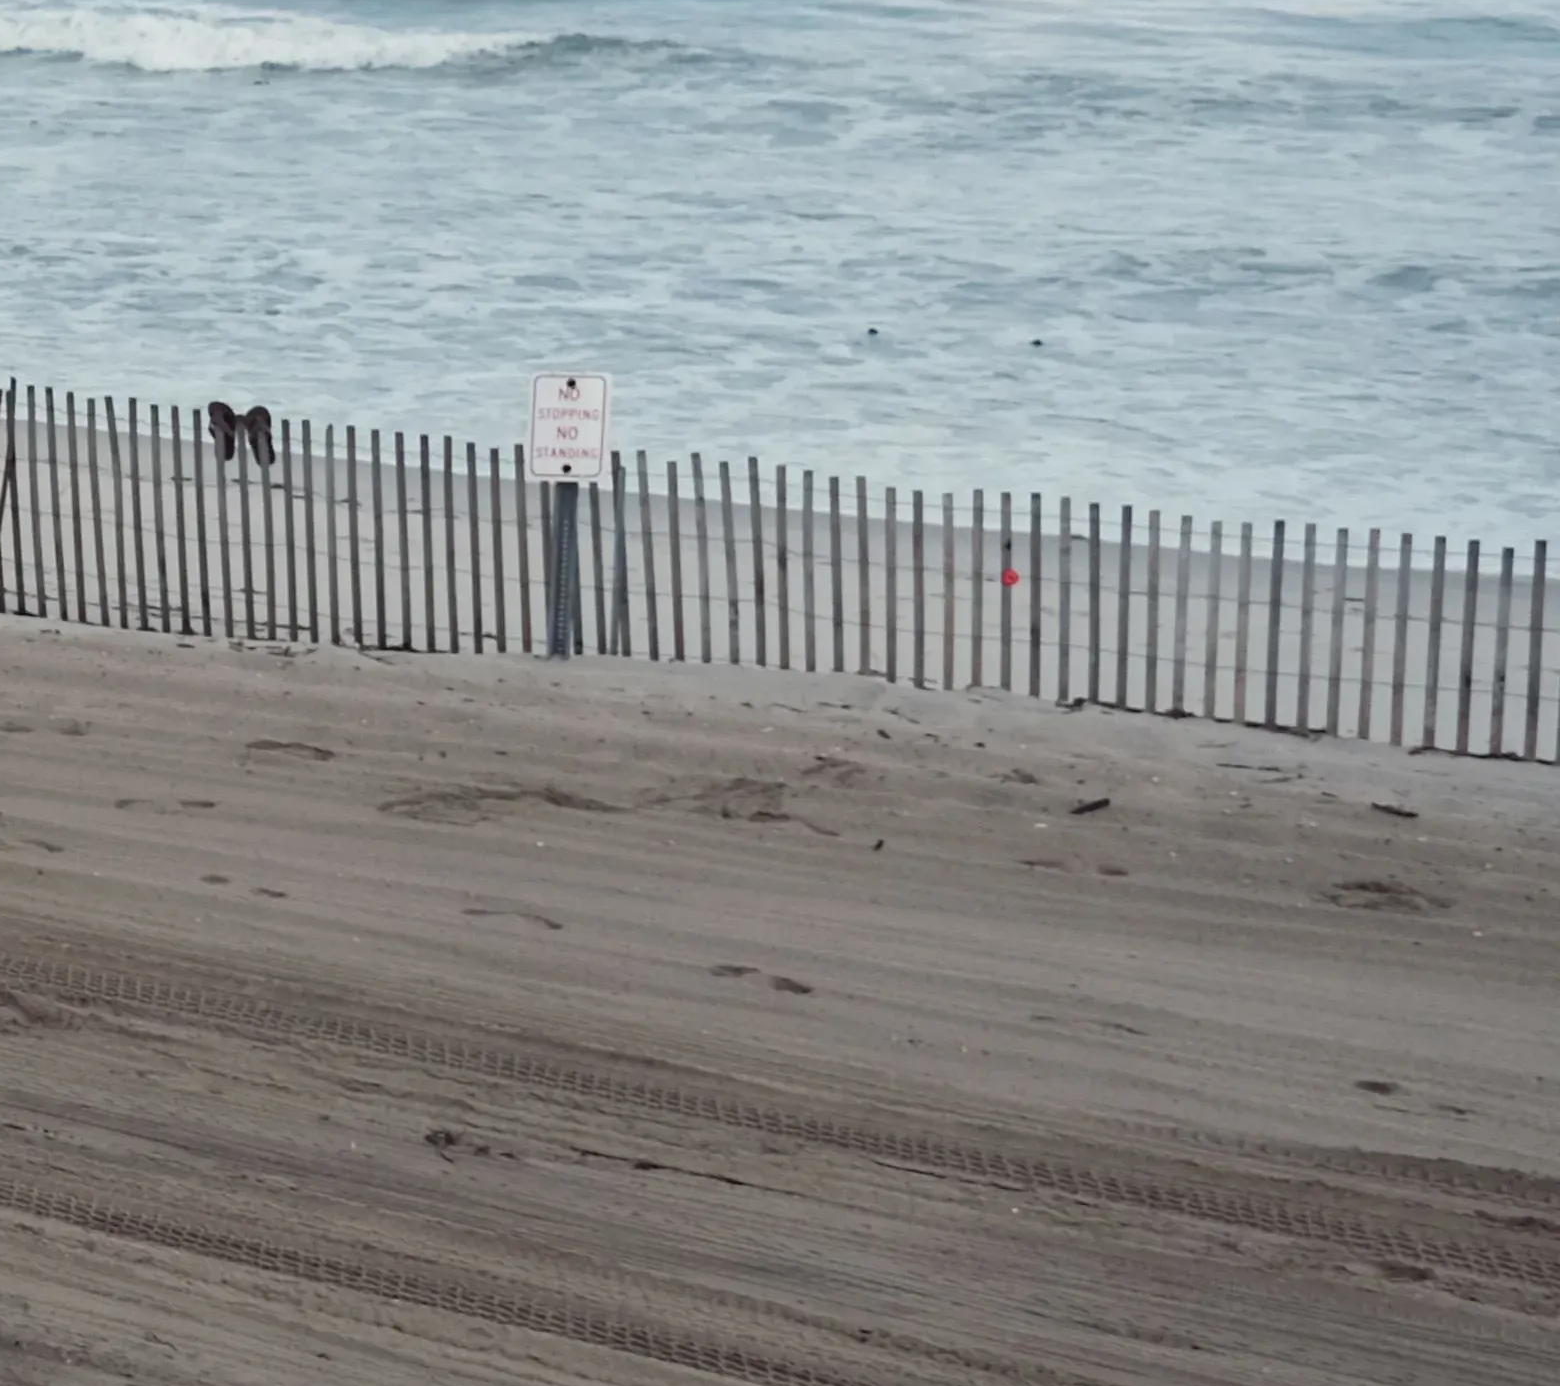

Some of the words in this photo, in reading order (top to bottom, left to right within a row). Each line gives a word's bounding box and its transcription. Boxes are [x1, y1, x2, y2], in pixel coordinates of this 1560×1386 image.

[558, 386, 581, 402] NO
[537, 407, 600, 421] STOPPING
[556, 425, 579, 441] NO
